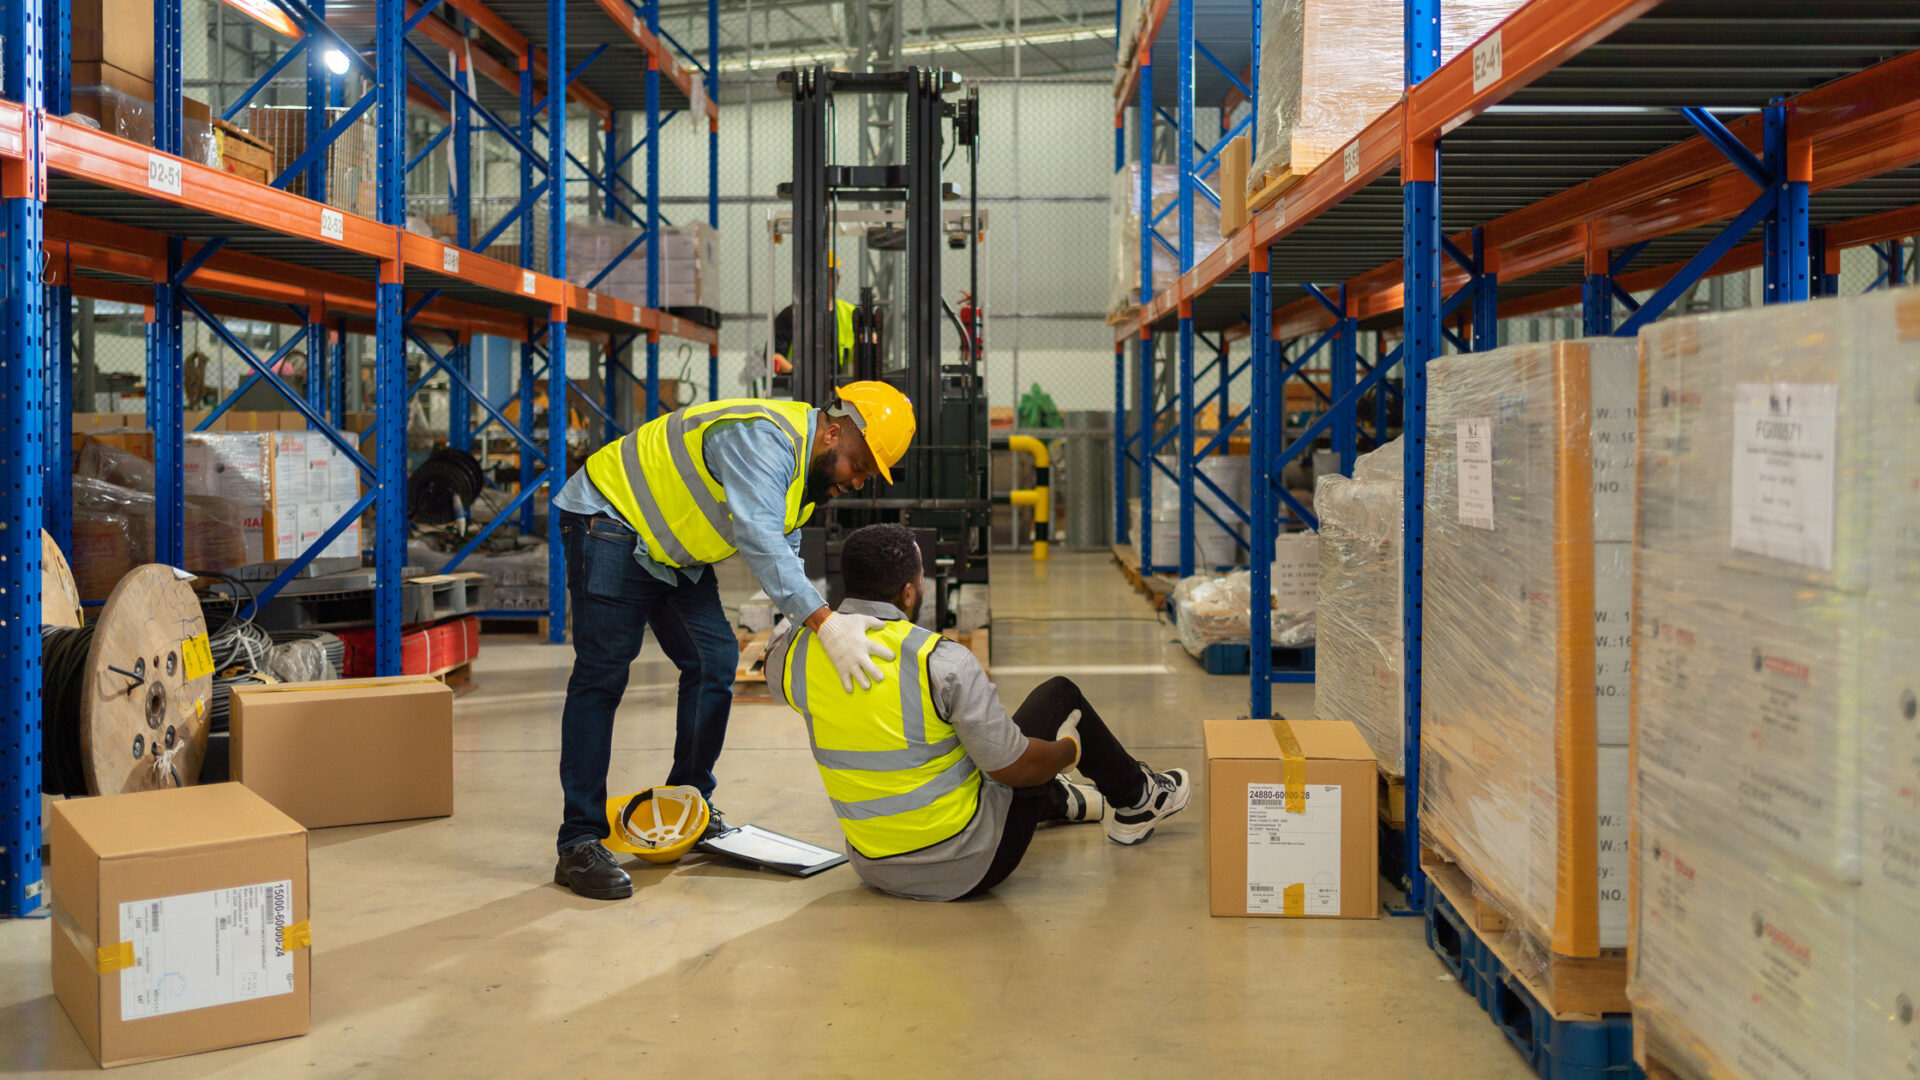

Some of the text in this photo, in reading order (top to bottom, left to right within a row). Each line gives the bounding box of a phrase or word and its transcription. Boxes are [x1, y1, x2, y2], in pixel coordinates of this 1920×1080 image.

[1474, 41, 1500, 81] E2-41
[149, 161, 180, 187] D2-51
[322, 215, 343, 234] D2-52
[1249, 790, 1310, 800] 24880-60000-28
[273, 883, 285, 958] 15000-60000-24
